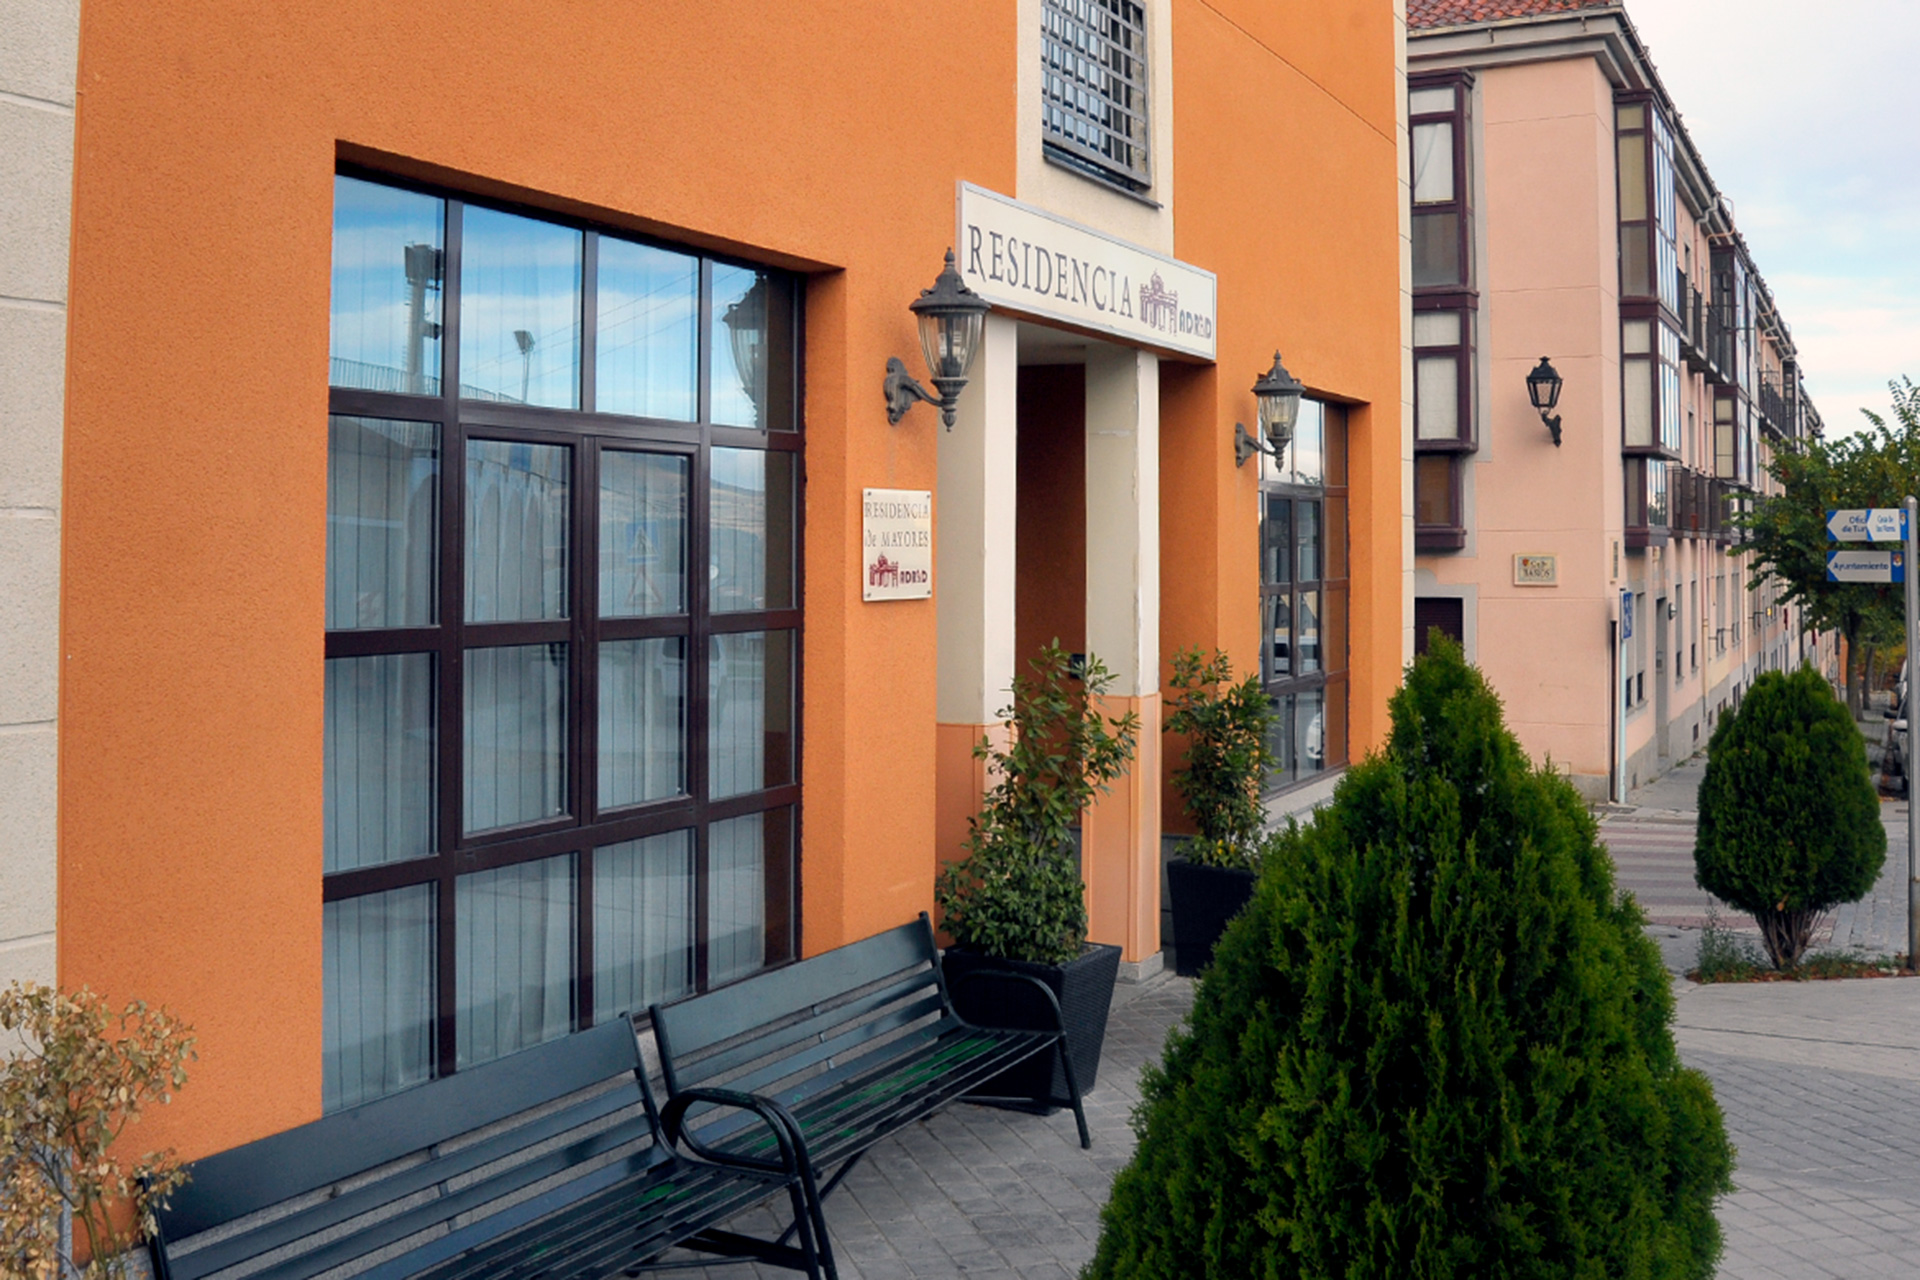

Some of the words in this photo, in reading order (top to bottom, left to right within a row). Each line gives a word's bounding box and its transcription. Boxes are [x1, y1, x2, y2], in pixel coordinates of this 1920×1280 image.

[967, 224, 1133, 318] RESIDENCIA
[864, 501, 929, 519] RESIDENCIA
[880, 530, 929, 548] MAYORES
[1833, 561, 1889, 572] Ayuntamiento
